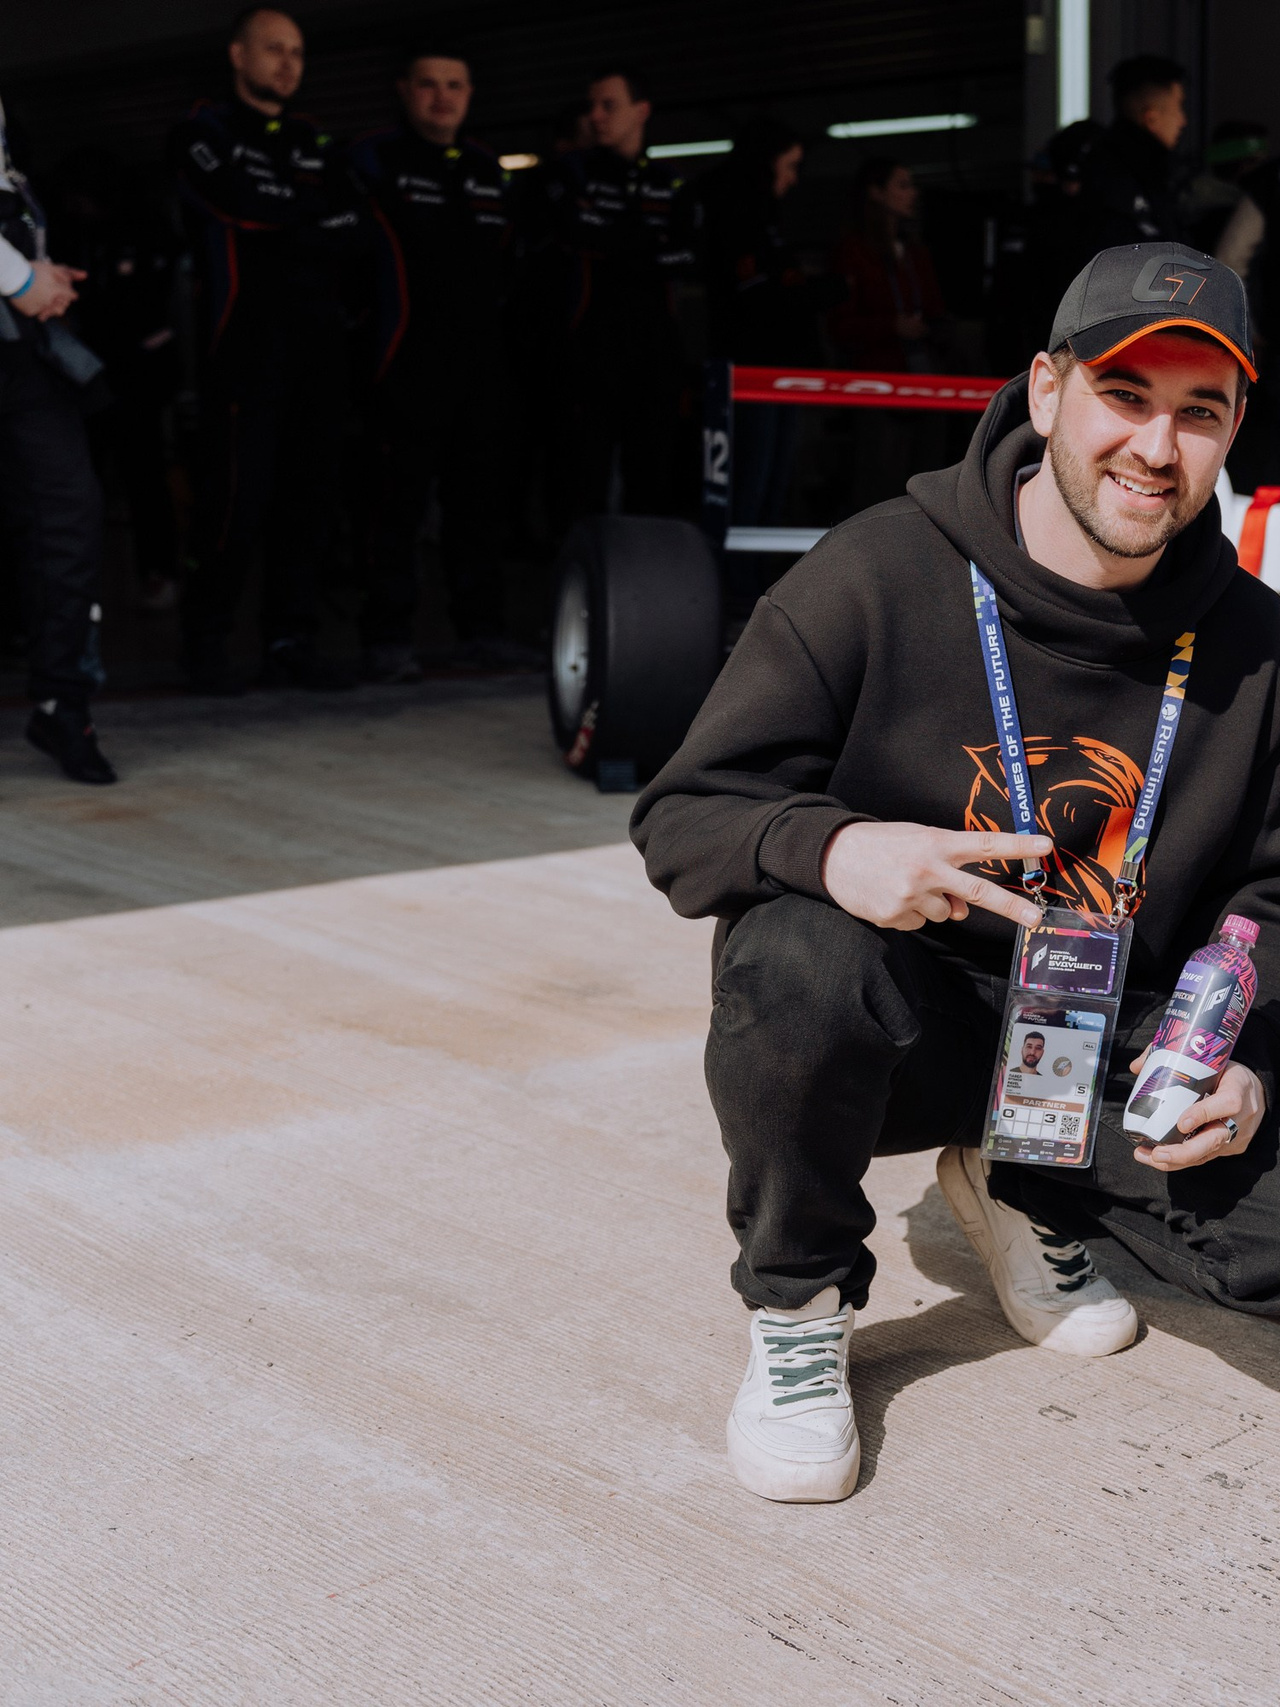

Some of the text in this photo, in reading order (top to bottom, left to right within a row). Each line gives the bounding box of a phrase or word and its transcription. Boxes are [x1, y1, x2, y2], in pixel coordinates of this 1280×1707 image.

[703, 427, 730, 487] 12
[985, 623, 1031, 824] GAMES OF THE FUTURE
[1049, 953, 1078, 962] ИГРЫ
[1048, 960, 1103, 971] БУДУЩЕГО
[1077, 1086, 1086, 1095] S
[1022, 1098, 1067, 1110] PARTNER
[1044, 1113, 1056, 1124] 3
